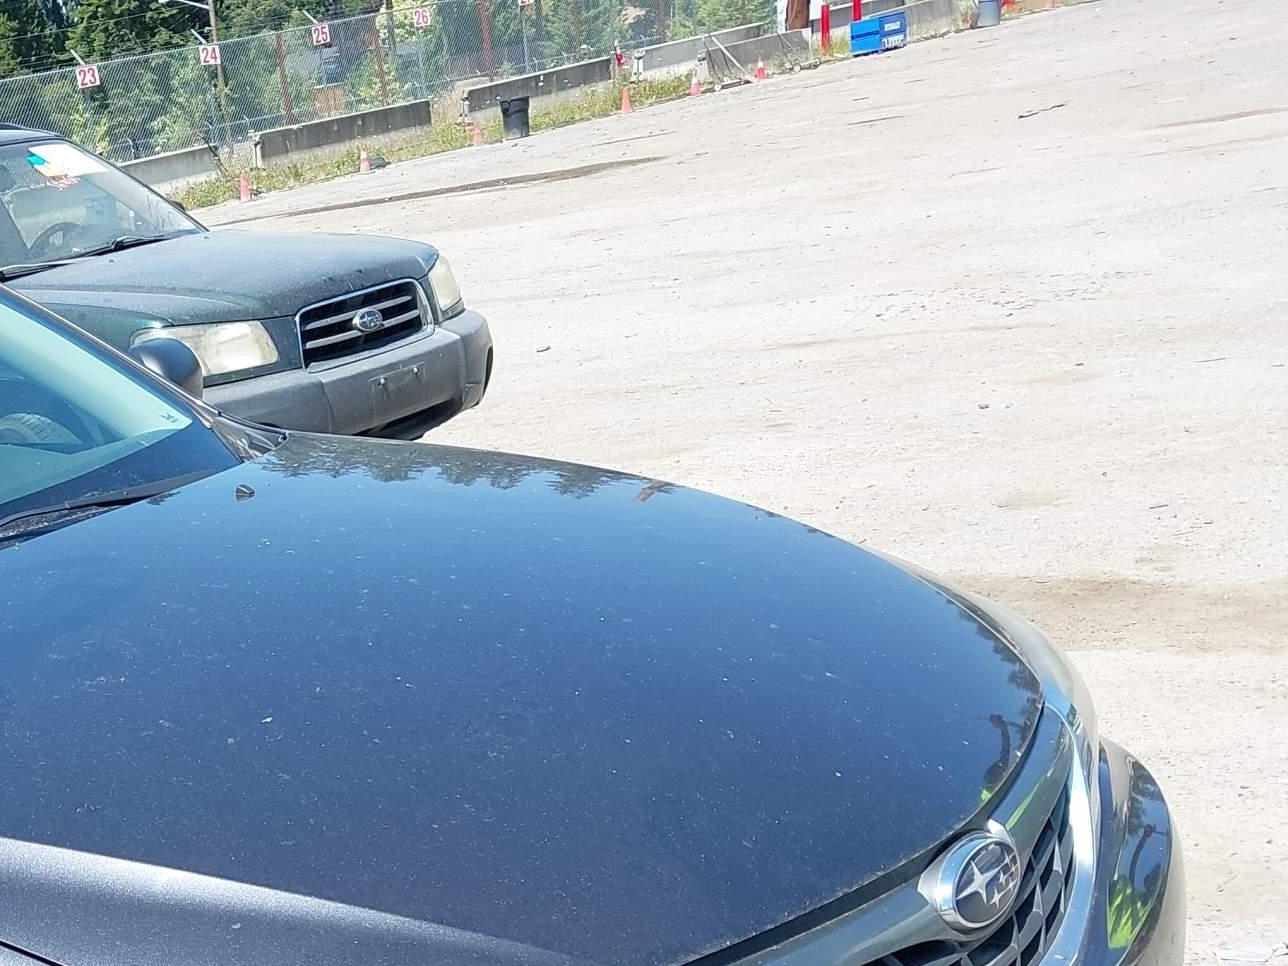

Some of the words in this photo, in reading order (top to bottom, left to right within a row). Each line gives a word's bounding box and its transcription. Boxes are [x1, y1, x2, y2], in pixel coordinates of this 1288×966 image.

[415, 8, 429, 27] 26
[313, 26, 329, 44] 25
[201, 46, 219, 64] 24
[79, 67, 97, 86] 23
